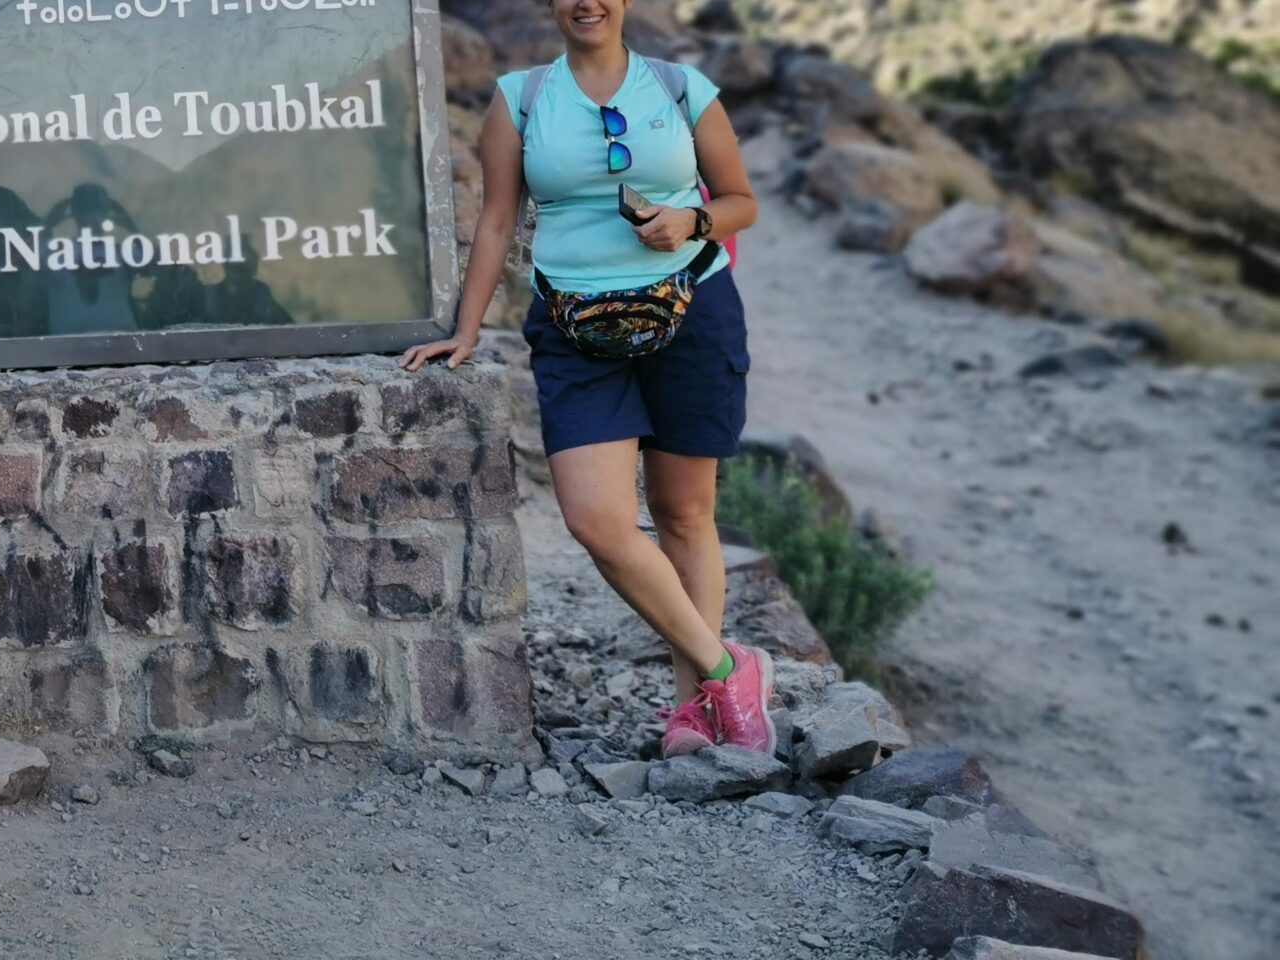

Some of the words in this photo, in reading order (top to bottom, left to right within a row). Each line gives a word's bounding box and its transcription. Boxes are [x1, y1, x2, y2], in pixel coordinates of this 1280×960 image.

[102, 93, 163, 141] de
[173, 79, 385, 136] Toubkal
[261, 208, 398, 261] Park
